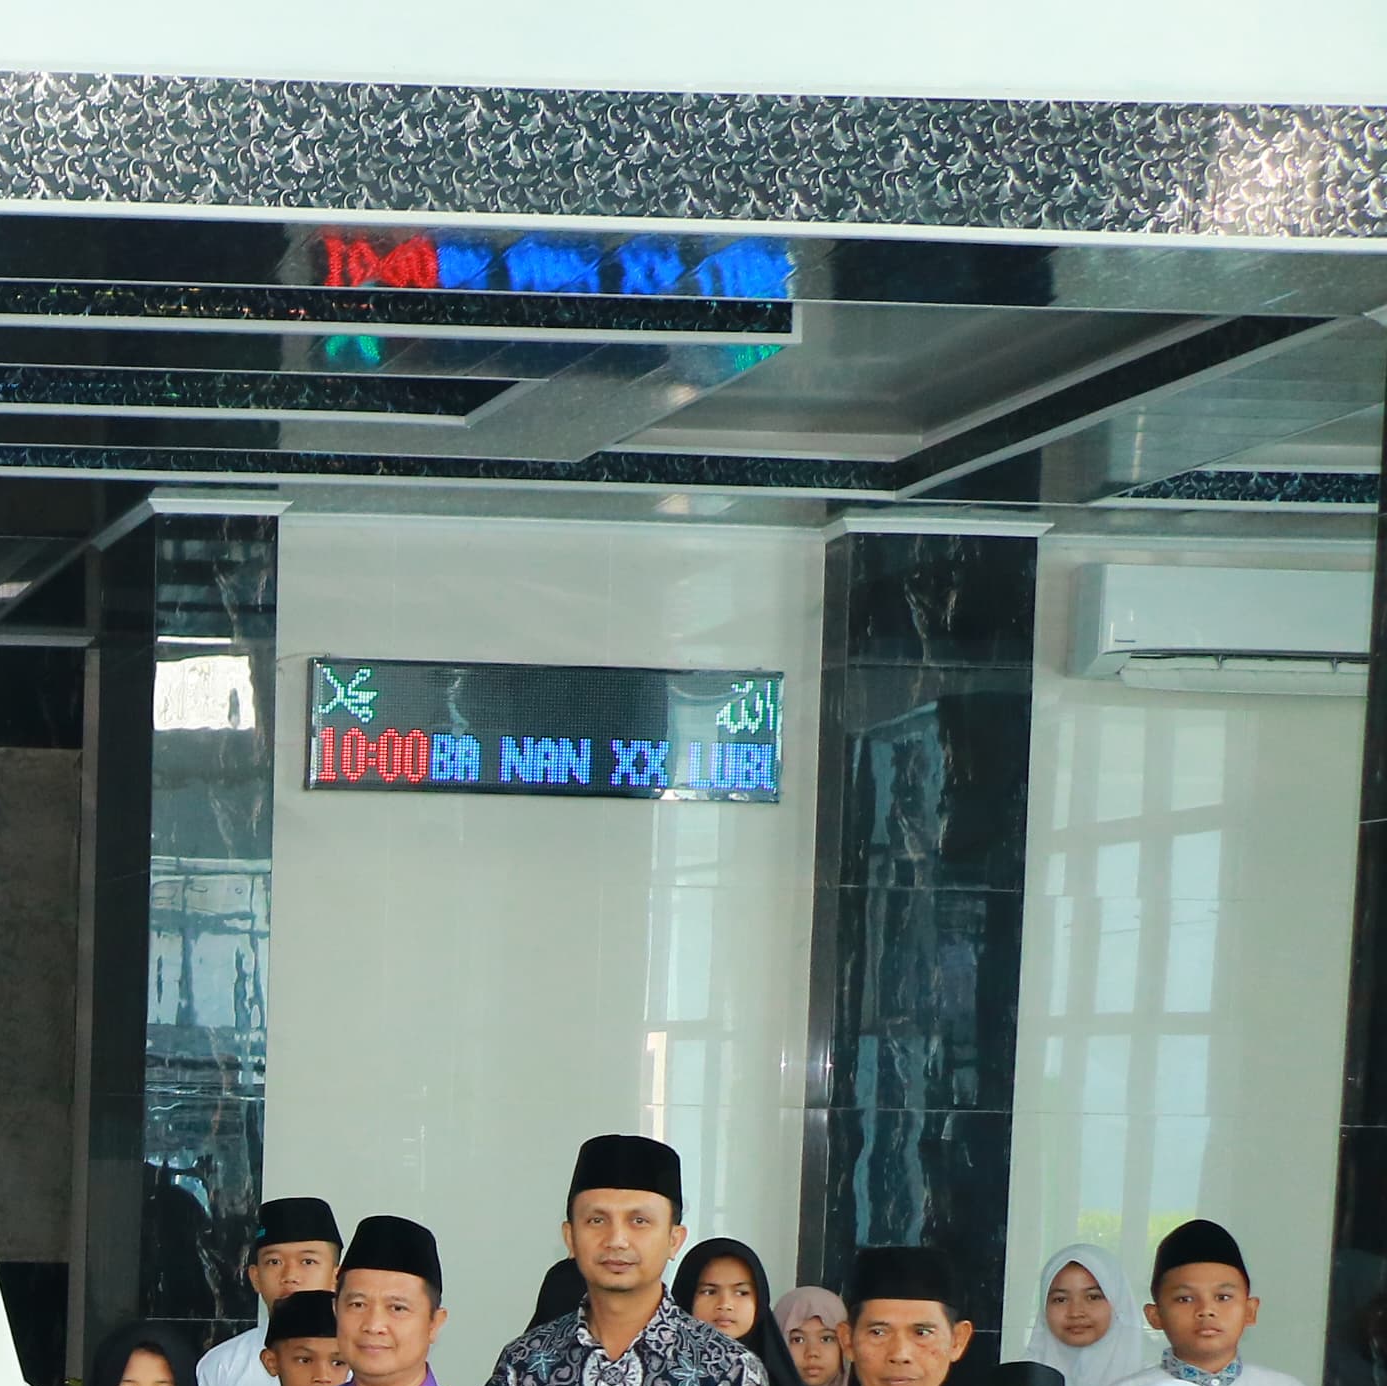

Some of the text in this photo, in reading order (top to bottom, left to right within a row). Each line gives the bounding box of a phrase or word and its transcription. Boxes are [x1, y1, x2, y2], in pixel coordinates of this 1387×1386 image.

[318, 726, 429, 783] 10:00
[430, 733, 481, 782] BA
[500, 736, 592, 784] NAN
[611, 739, 668, 787] XX
